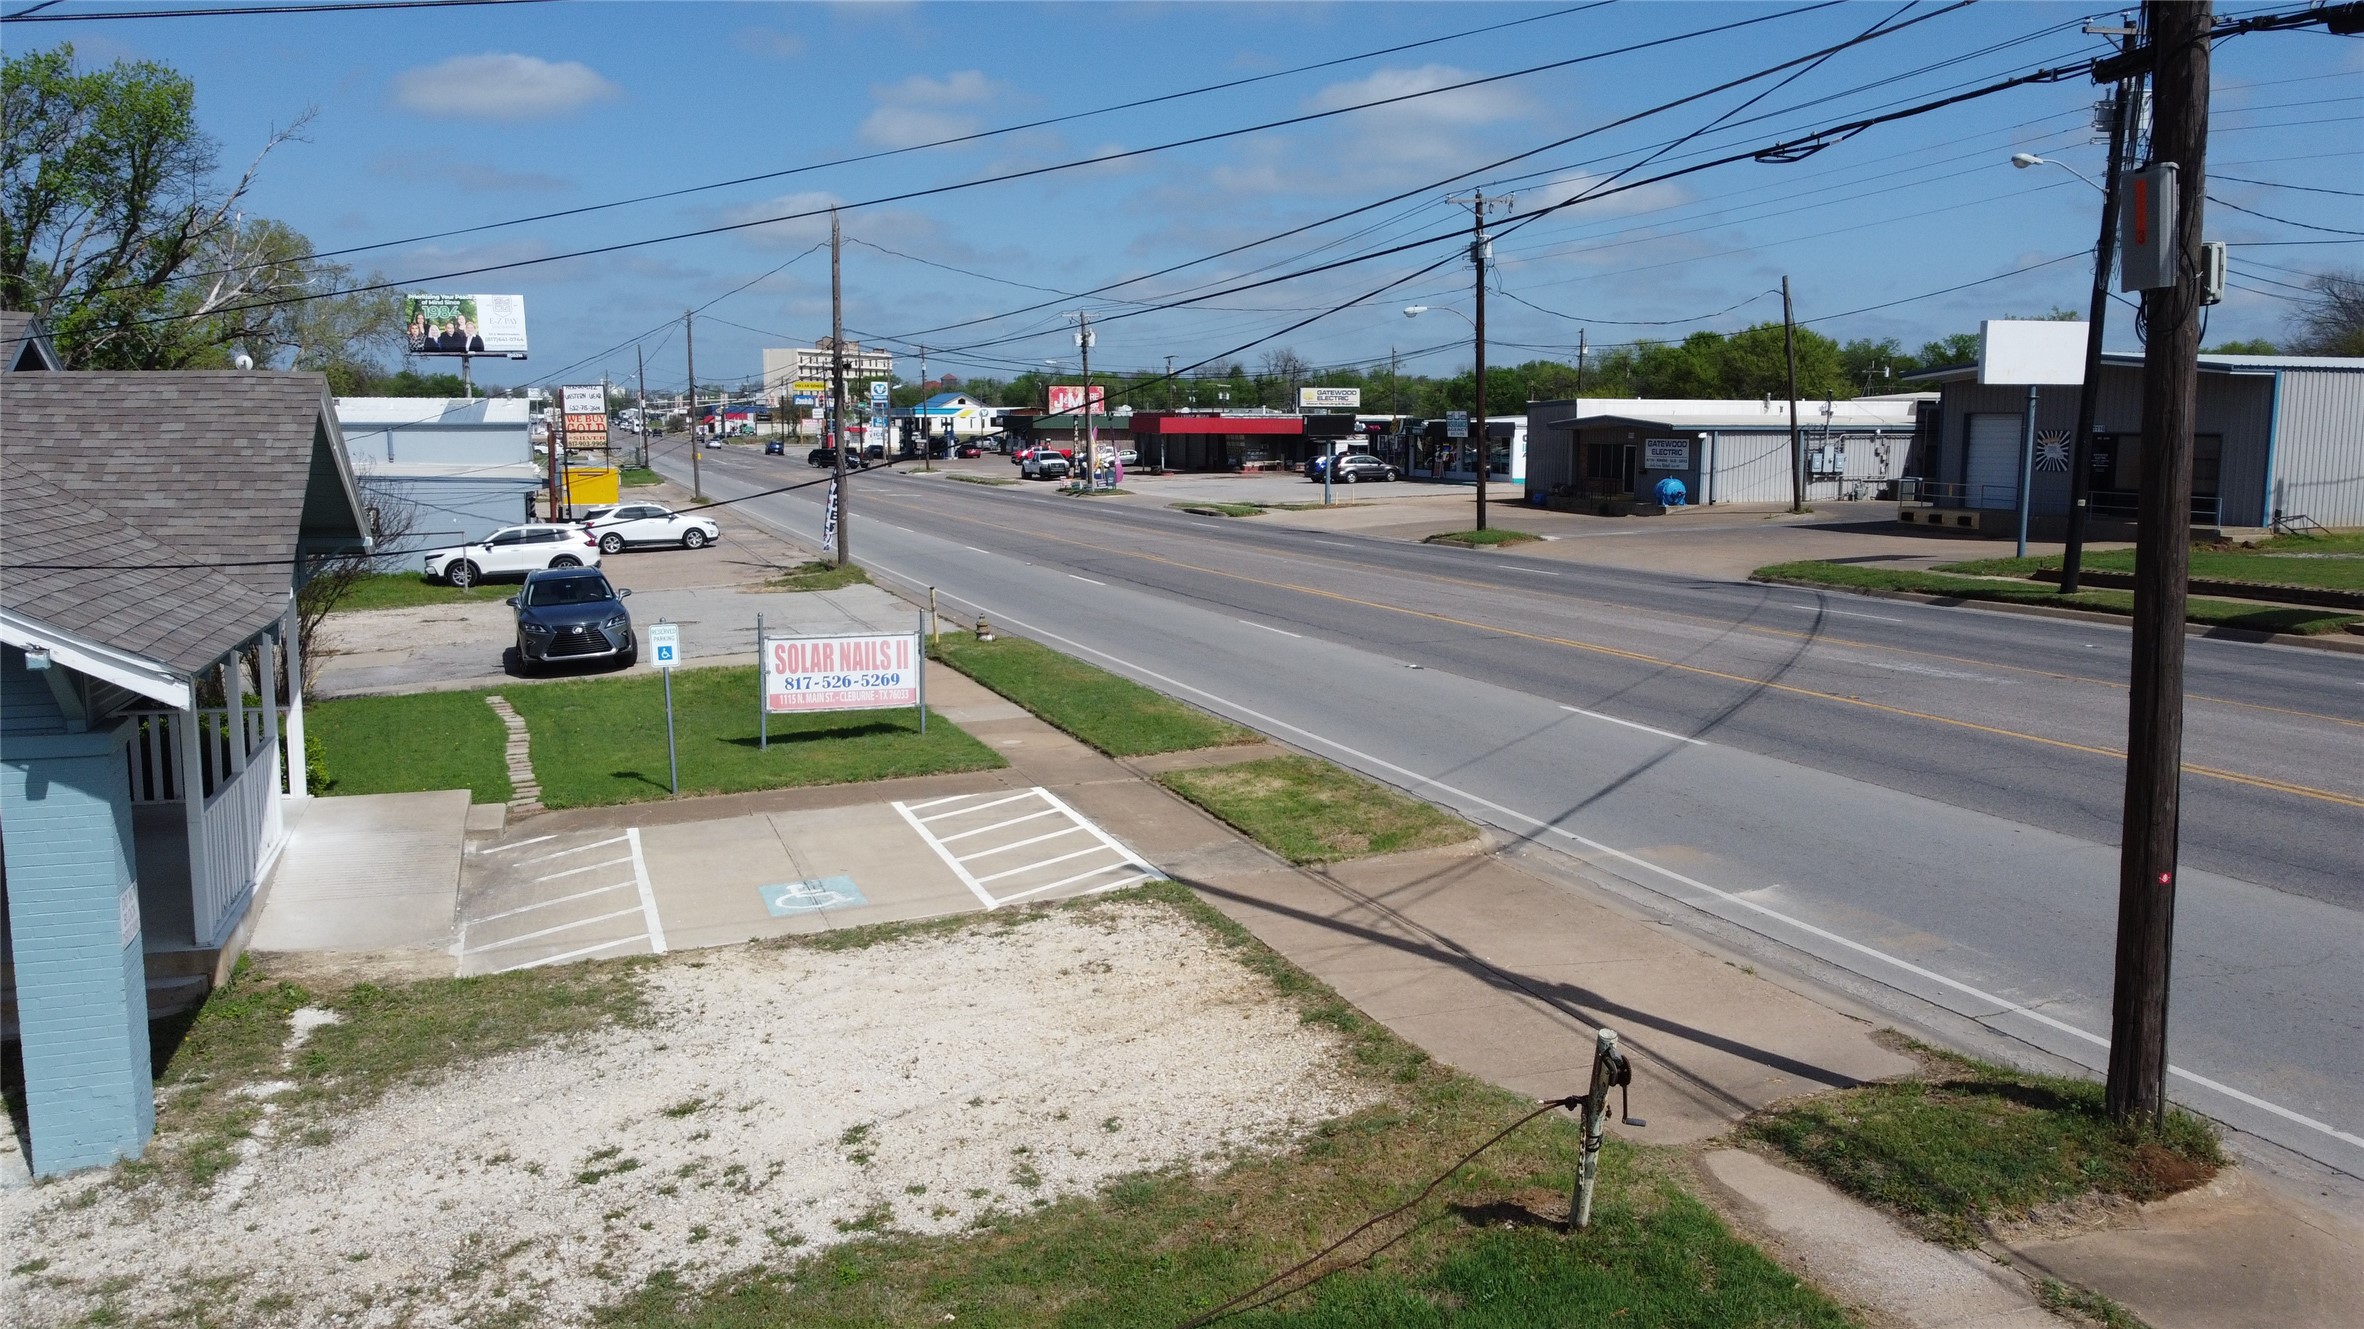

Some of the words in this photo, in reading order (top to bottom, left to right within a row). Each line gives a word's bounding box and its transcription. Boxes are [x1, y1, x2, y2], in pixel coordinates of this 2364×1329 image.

[422, 306, 460, 318] 1984
[566, 424, 606, 432] GOLD
[774, 642, 834, 674] SOLAR
[840, 640, 892, 672] NAILS
[896, 640, 908, 670] II
[780, 694, 796, 704] 1115
[796, 694, 805, 704] N.
[806, 692, 825, 703] MAIN
[840, 690, 875, 701] CLEBURNE
[879, 690, 888, 700] TX
[889, 689, 909, 700] 76033
